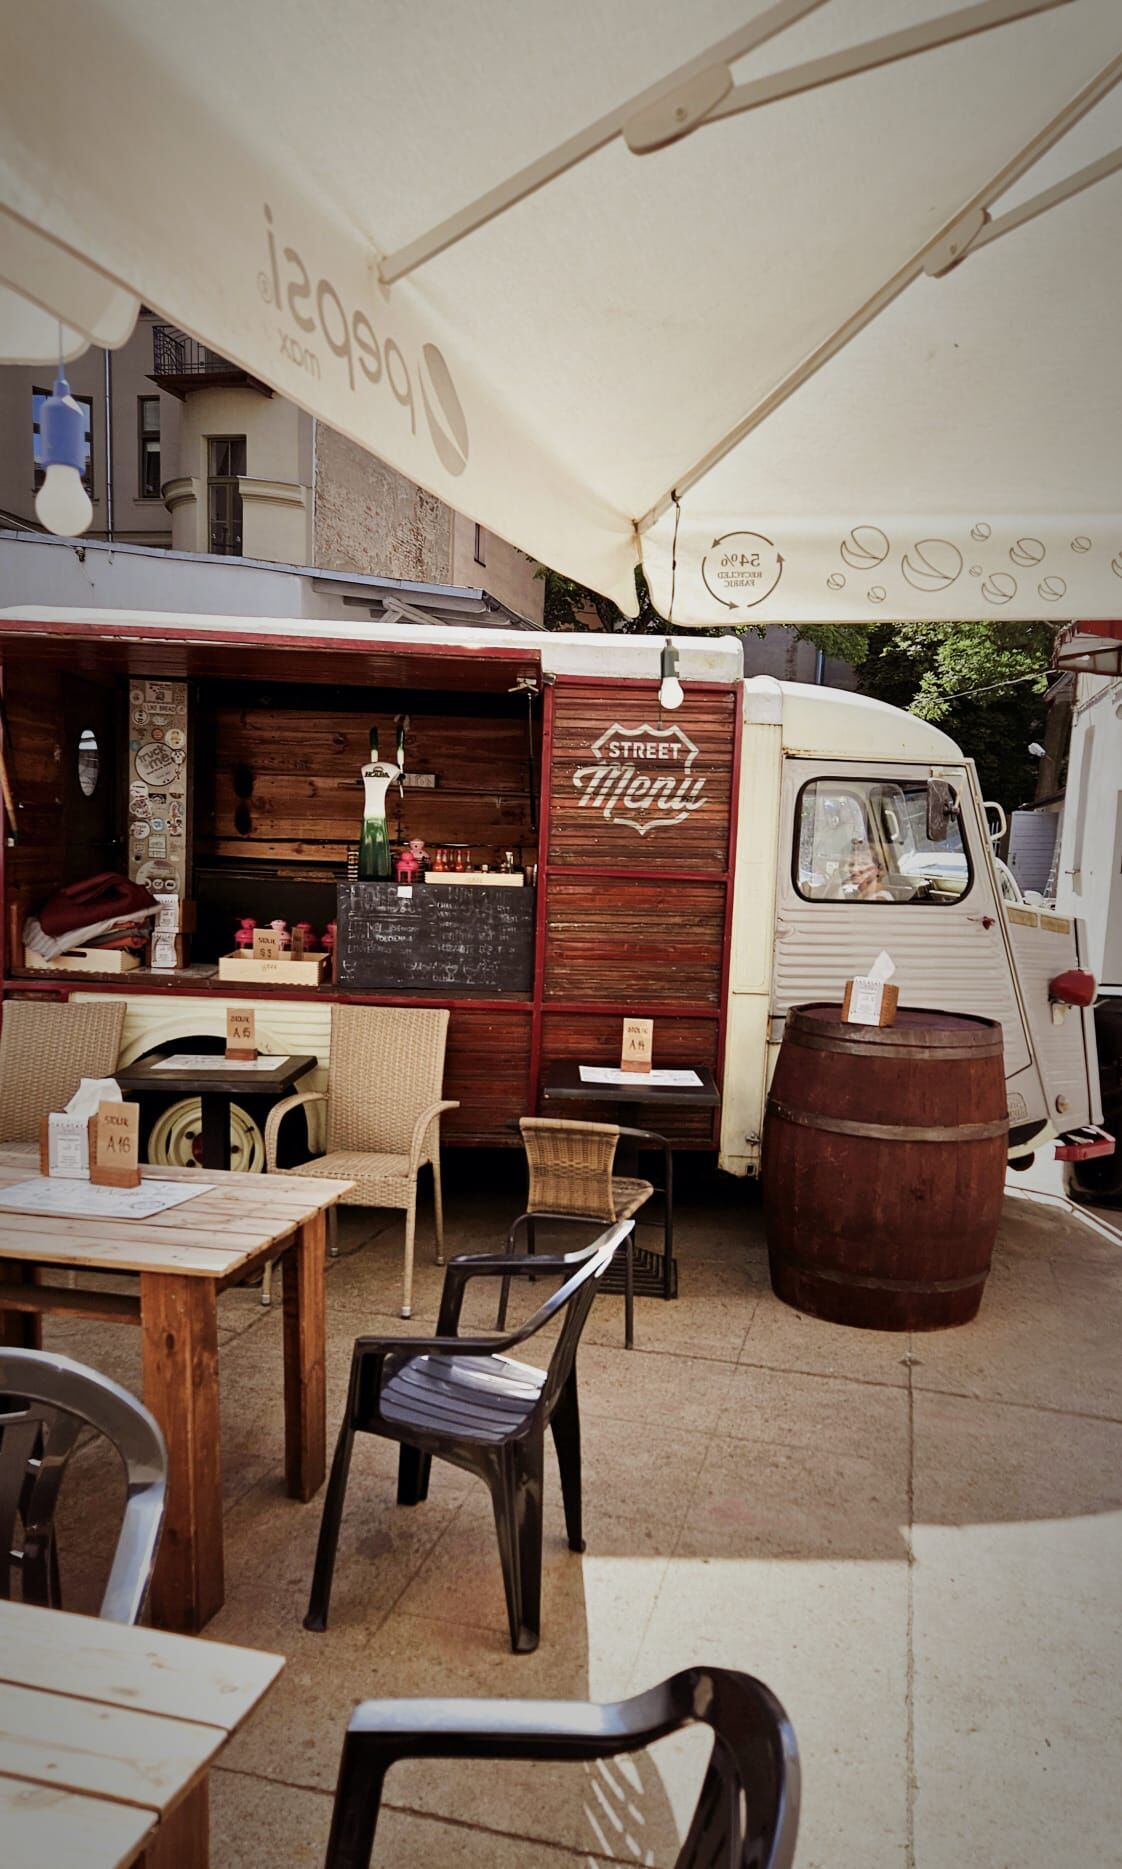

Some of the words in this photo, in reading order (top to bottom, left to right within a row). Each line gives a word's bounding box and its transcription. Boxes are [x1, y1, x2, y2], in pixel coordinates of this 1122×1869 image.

[159, 705, 175, 713] BREAD
[608, 741, 682, 759] STREET
[572, 761, 709, 819] Menu
